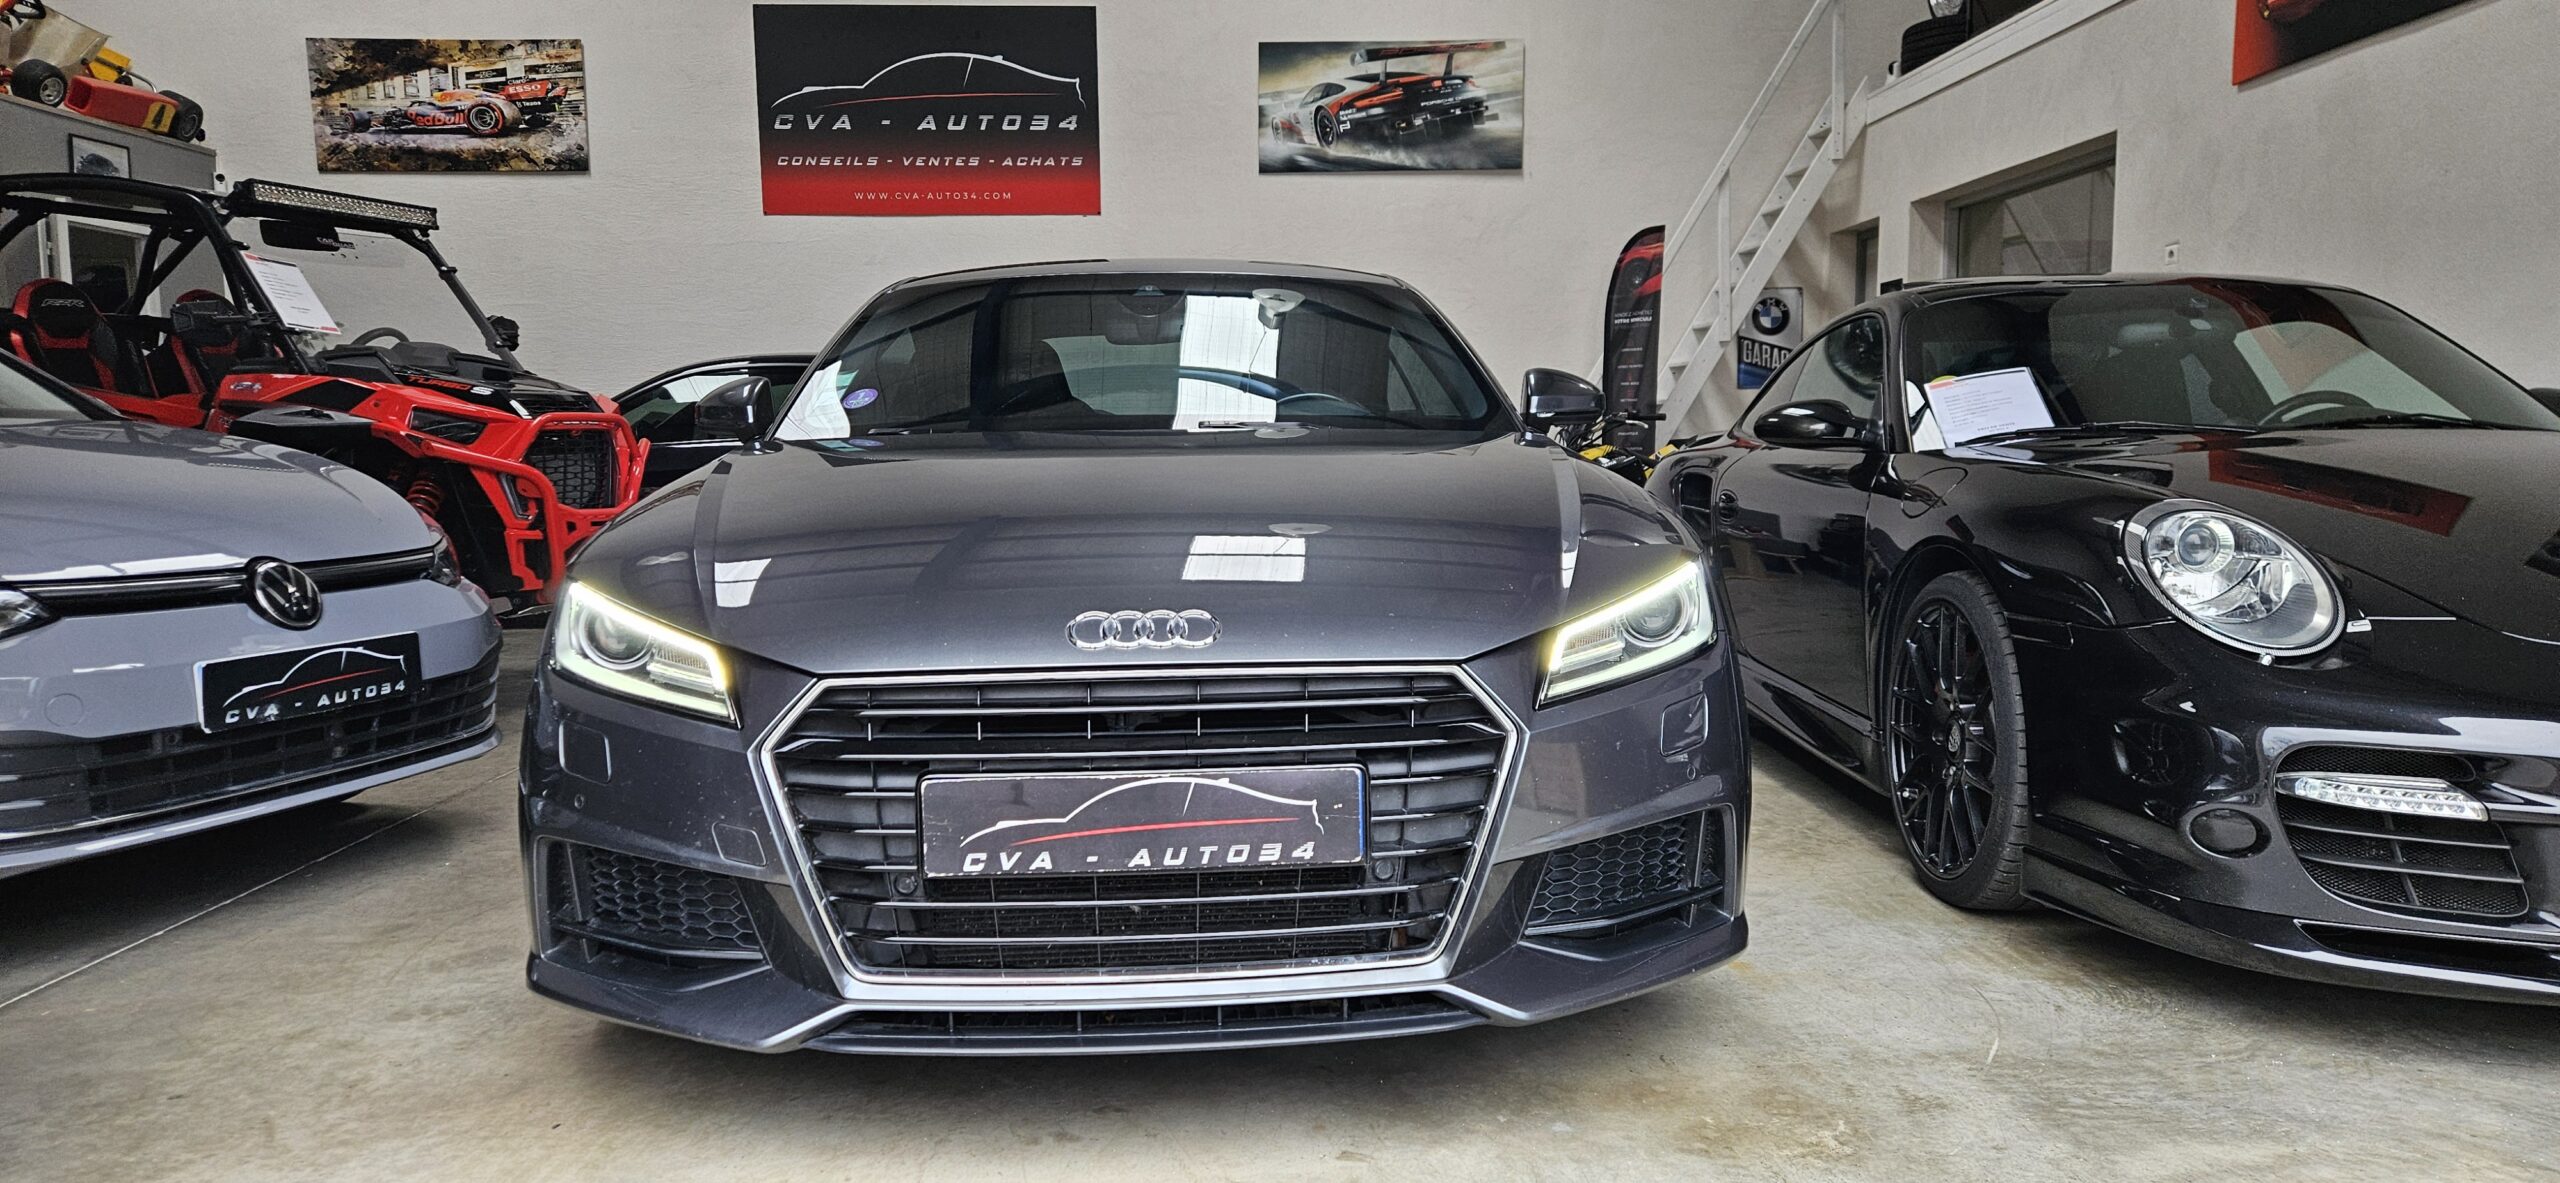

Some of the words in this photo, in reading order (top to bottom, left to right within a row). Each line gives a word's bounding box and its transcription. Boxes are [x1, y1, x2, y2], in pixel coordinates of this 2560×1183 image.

[508, 84, 541, 93] ESSO
[151, 104, 167, 129] 4
[774, 114, 851, 130] CVA
[917, 114, 1078, 131] AUTO34
[777, 156, 879, 166] CONSEILS
[902, 156, 980, 166] VENTES
[1002, 156, 1084, 166] ACHATS
[854, 192, 1011, 200] WWW.CVA-AUTO34.COM
[1755, 298, 1788, 312] BMW
[408, 374, 472, 391] TURBO
[470, 386, 495, 396] S
[225, 703, 280, 724] CVA
[317, 680, 406, 707] AUTO34
[962, 851, 1053, 872] CVA
[1085, 855, 1098, 863] -
[1128, 841, 1316, 869] AUTO34
